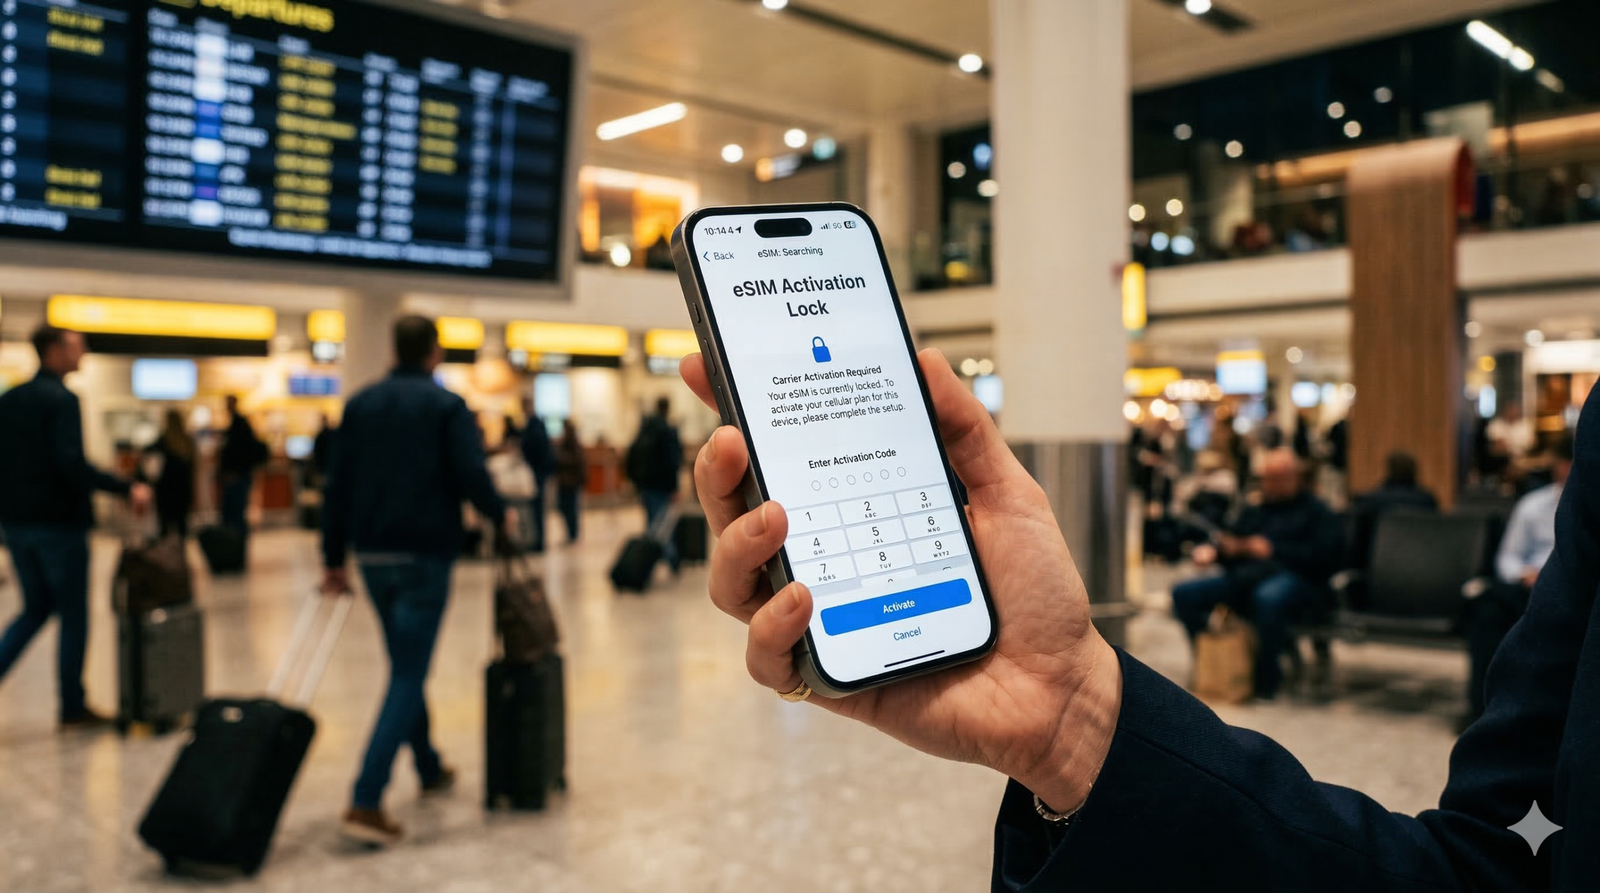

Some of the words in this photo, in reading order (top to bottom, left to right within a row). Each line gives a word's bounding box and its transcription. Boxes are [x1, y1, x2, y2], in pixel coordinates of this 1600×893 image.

[704, 227, 726, 235] 10:14
[713, 252, 735, 260] Back
[758, 248, 781, 258] eSIM:
[783, 246, 823, 257] Searching
[733, 280, 778, 297] eSIM
[782, 274, 866, 294] Activation
[786, 300, 829, 317] Lock
[773, 374, 802, 386] Carrier
[804, 370, 845, 382] Activation
[846, 365, 882, 378] Required
[768, 391, 786, 401] Your
[789, 388, 810, 399] eSIM
[811, 386, 818, 396] is
[820, 383, 854, 395] currently
[855, 379, 884, 391] locked.
[884, 378, 894, 387] To
[771, 403, 803, 414] activate
[805, 401, 822, 412] your
[824, 395, 852, 407] cellular
[854, 393, 871, 405] plan
[872, 392, 883, 401] for
[884, 391, 898, 400] this
[771, 417, 802, 428] device,
[803, 412, 829, 425] please
[830, 407, 866, 420] complete
[868, 405, 881, 414] the
[883, 403, 906, 413] setup.
[809, 458, 831, 469] Enter
[833, 452, 874, 465] Activation
[875, 448, 896, 459] Code
[920, 492, 927, 501] 3
[864, 501, 871, 511] 2
[805, 512, 812, 521] 1
[928, 516, 935, 526] 6
[872, 526, 880, 536] 5
[813, 537, 821, 547] 4
[935, 540, 942, 550] 9
[879, 551, 886, 561] 8
[820, 563, 826, 573] 7
[883, 599, 915, 614] Activate
[893, 627, 922, 641] Cancel
